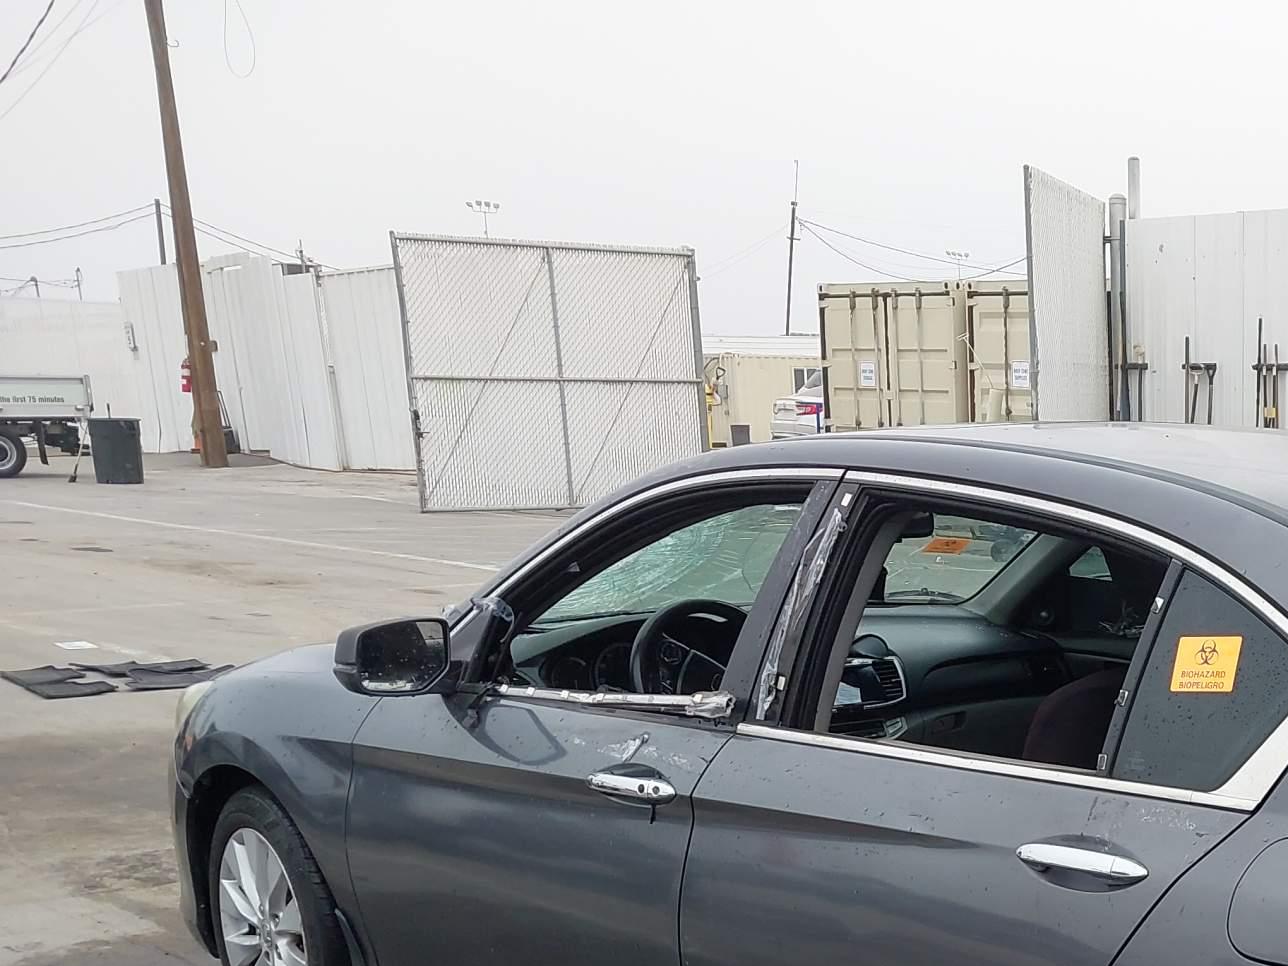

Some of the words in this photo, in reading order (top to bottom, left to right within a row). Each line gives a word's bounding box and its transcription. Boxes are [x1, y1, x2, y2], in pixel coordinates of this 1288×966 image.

[12, 395, 25, 403] first
[38, 395, 65, 403] minutes
[1180, 670, 1226, 679] BIOHAZARD
[1178, 681, 1225, 690] BIOPELIGRO
